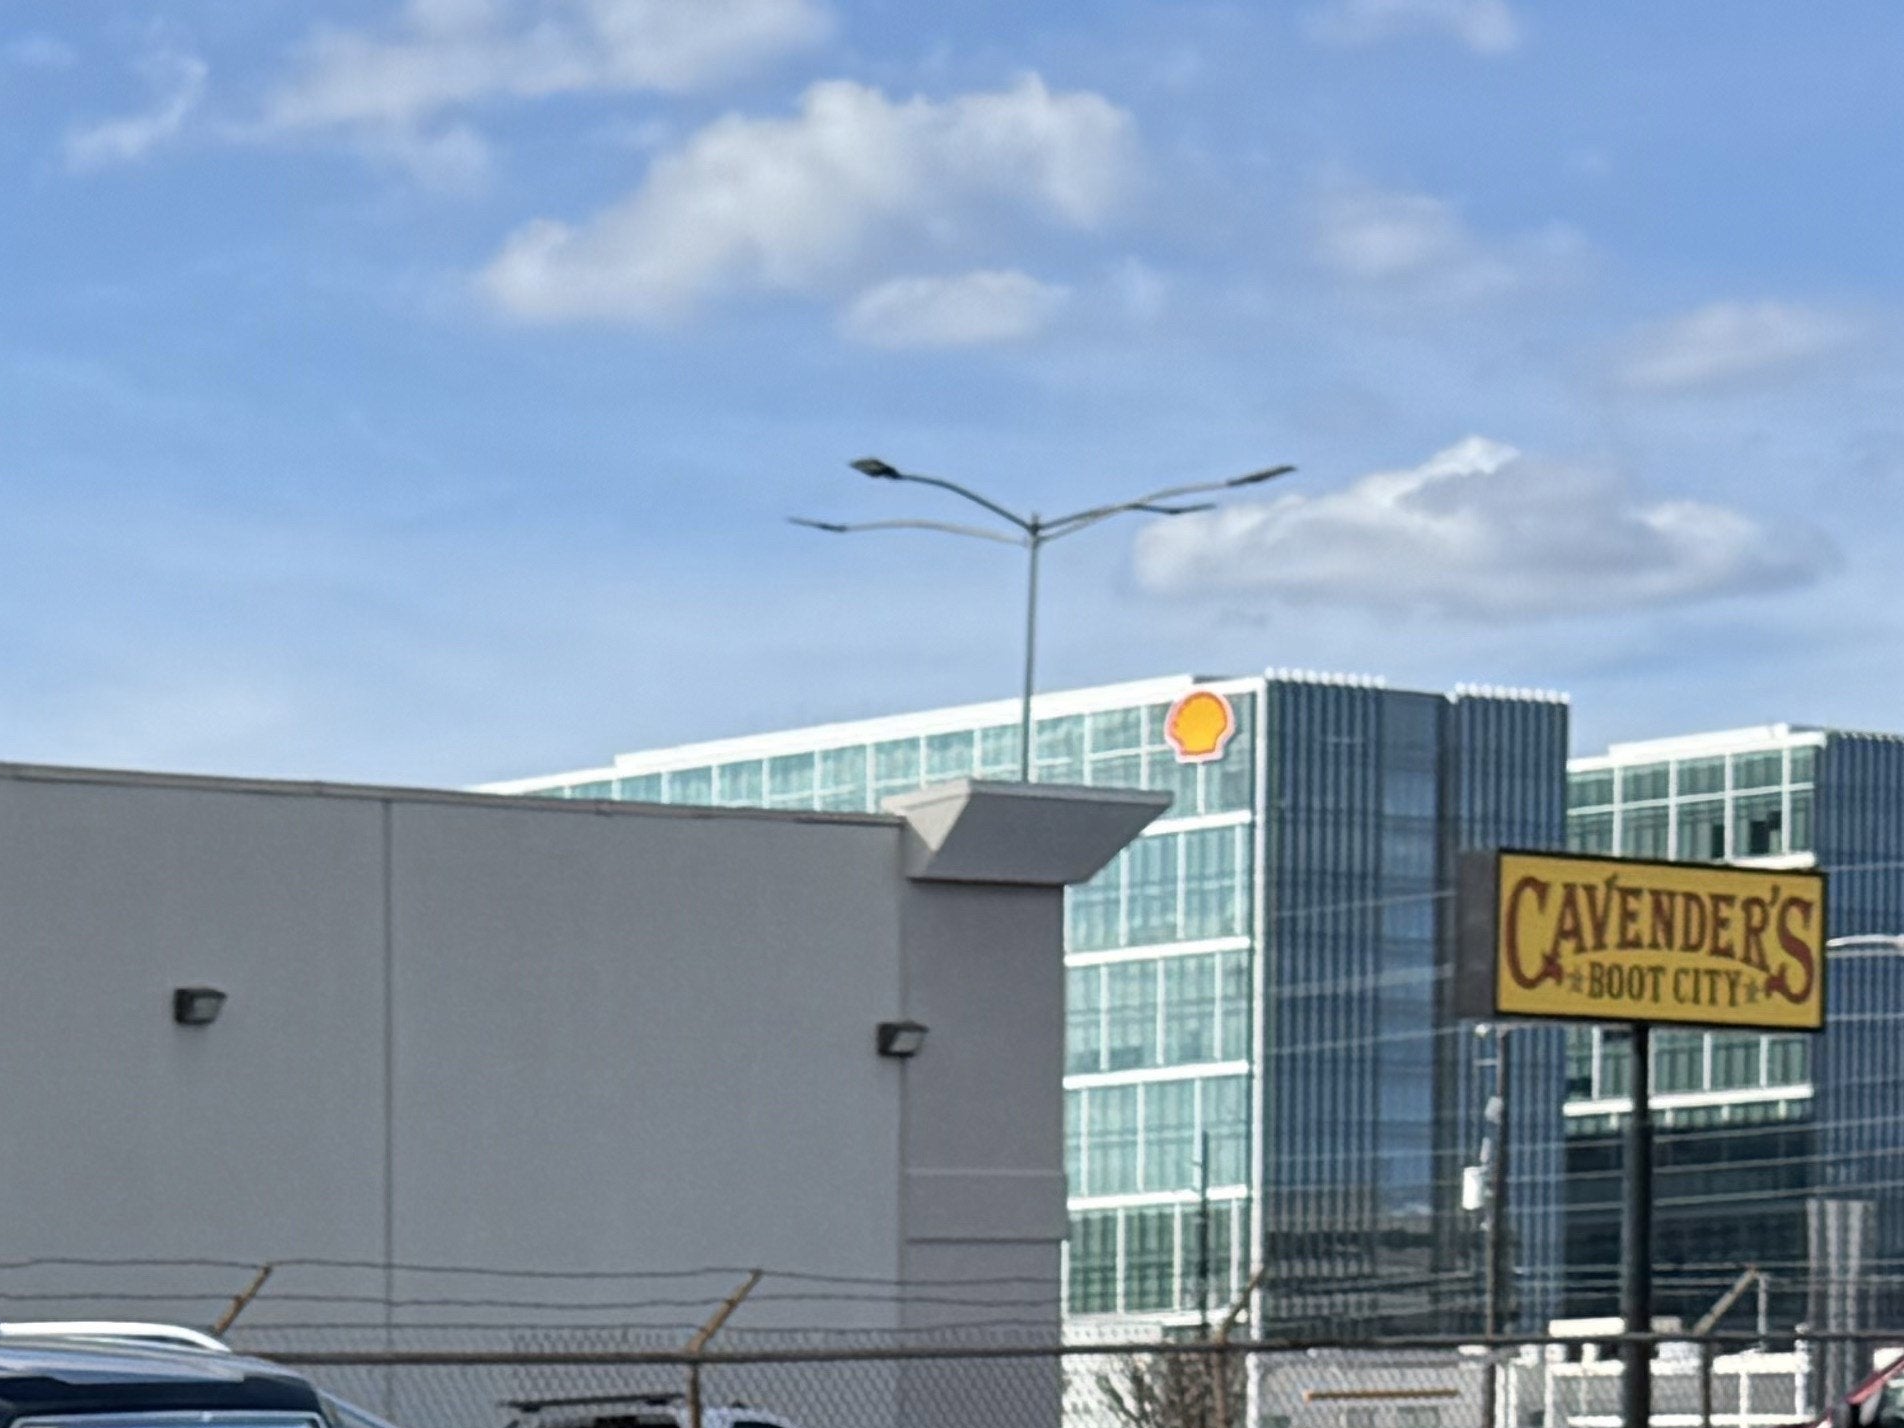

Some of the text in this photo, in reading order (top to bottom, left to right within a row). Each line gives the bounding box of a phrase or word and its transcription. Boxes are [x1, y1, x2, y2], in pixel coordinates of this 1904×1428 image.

[1505, 872, 1815, 1004] CAVENDER'S
[1588, 961, 1741, 1008] BOOT CITY
